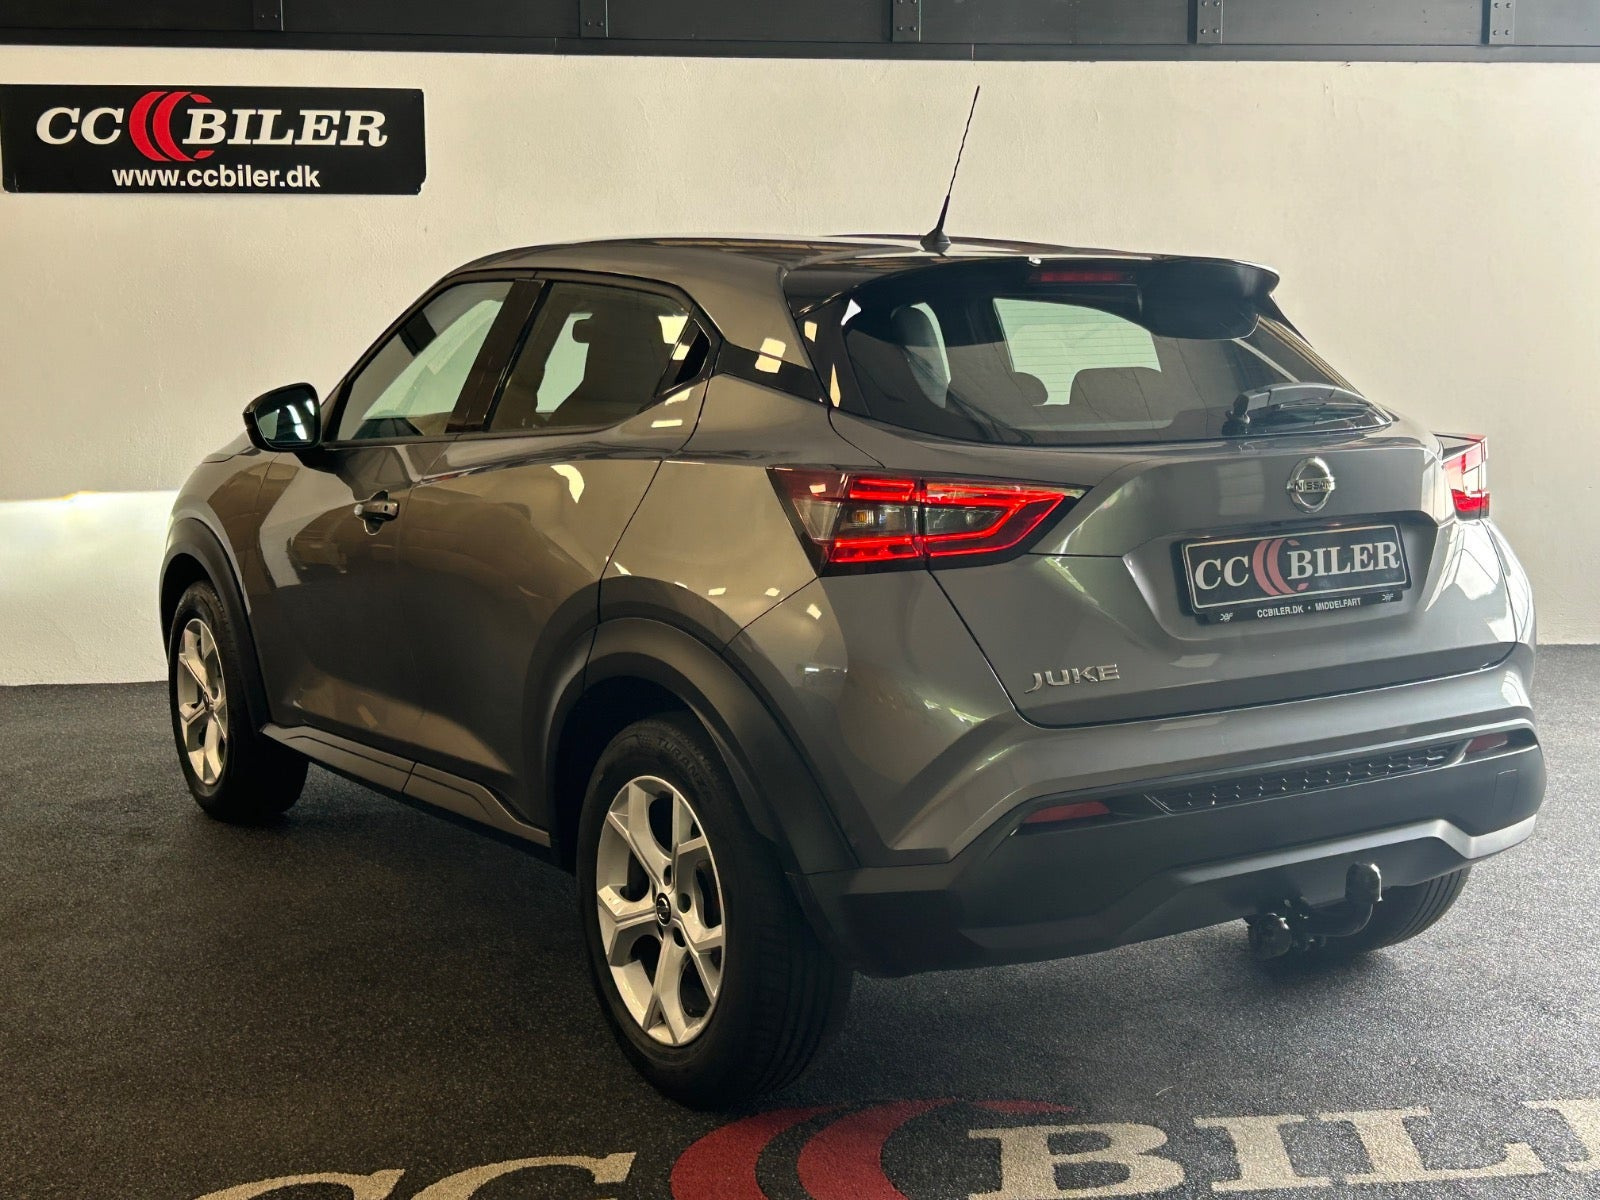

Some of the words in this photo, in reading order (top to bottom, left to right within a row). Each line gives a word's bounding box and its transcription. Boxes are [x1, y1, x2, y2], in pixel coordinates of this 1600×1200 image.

[35, 106, 125, 146] CC
[181, 107, 389, 148] BILER
[111, 164, 321, 189] www.ccbiler.dk
[1294, 479, 1333, 493] NISSAN
[1194, 555, 1250, 591] CC
[1286, 540, 1401, 581] BILER
[1256, 604, 1305, 618] CCBILER.DK
[1315, 597, 1362, 612] MIDDELFART
[1023, 663, 1121, 694] JUKE
